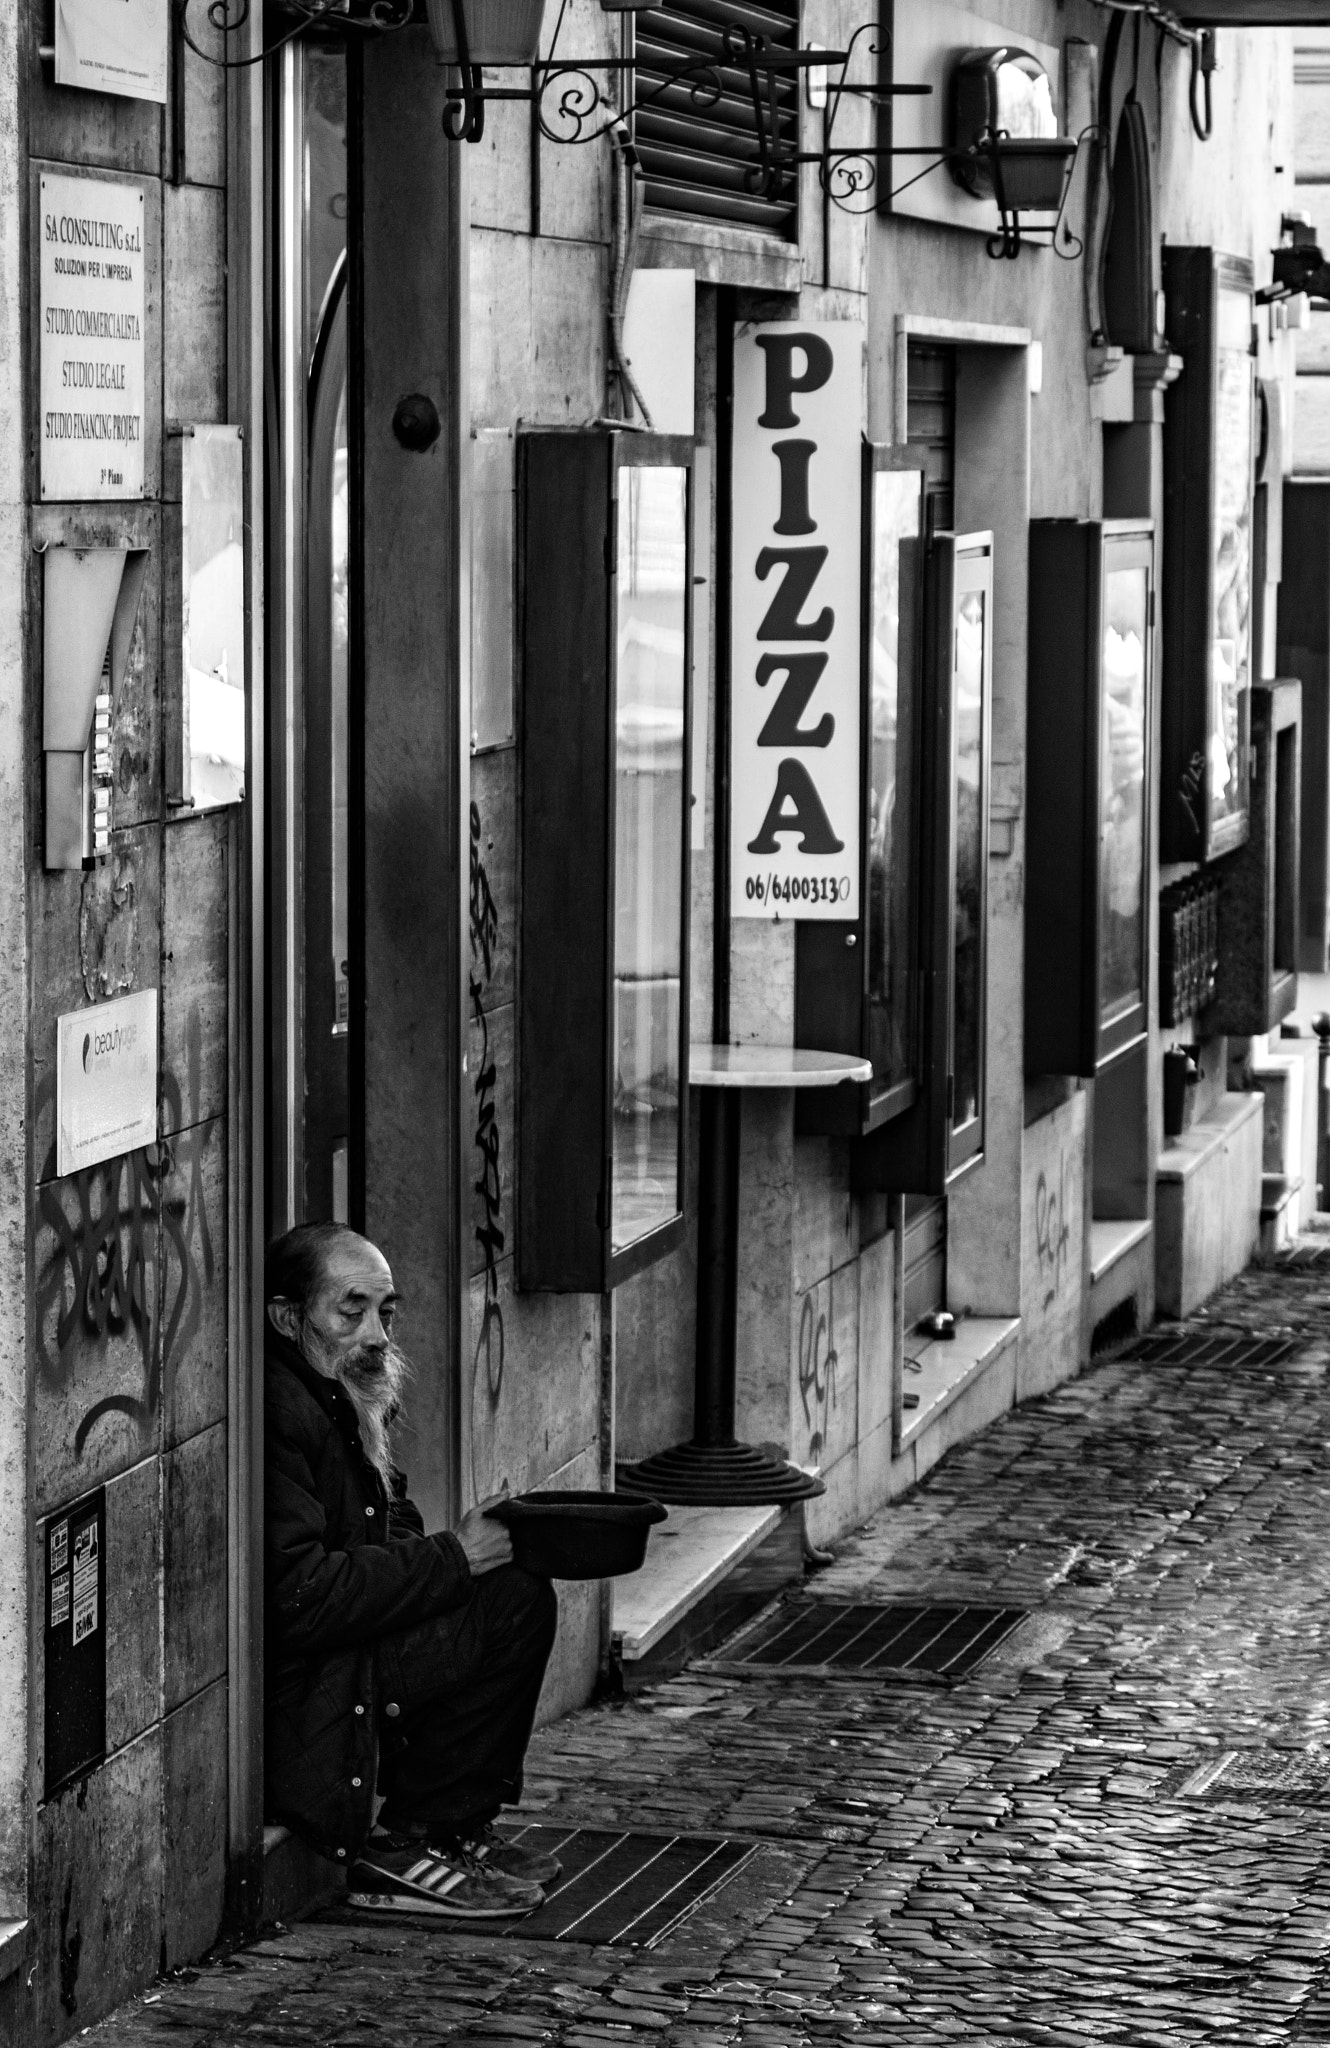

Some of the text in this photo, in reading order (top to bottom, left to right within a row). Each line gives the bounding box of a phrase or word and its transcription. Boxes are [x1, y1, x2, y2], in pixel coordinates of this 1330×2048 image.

[45, 214, 58, 242] SA
[60, 216, 123, 250] CONSULTING
[55, 257, 133, 281] SOLUZIONI PER L'IMPRESA
[46, 306, 141, 341] STUDIO COMMERCIALISTA
[62, 360, 126, 390] STUDIO LEGALE
[45, 411, 140, 447] STUDIO FINANCING PROJECT
[108, 468, 123, 485] Piano
[747, 332, 846, 855] PIZZA
[745, 872, 850, 906] 06/64003130
